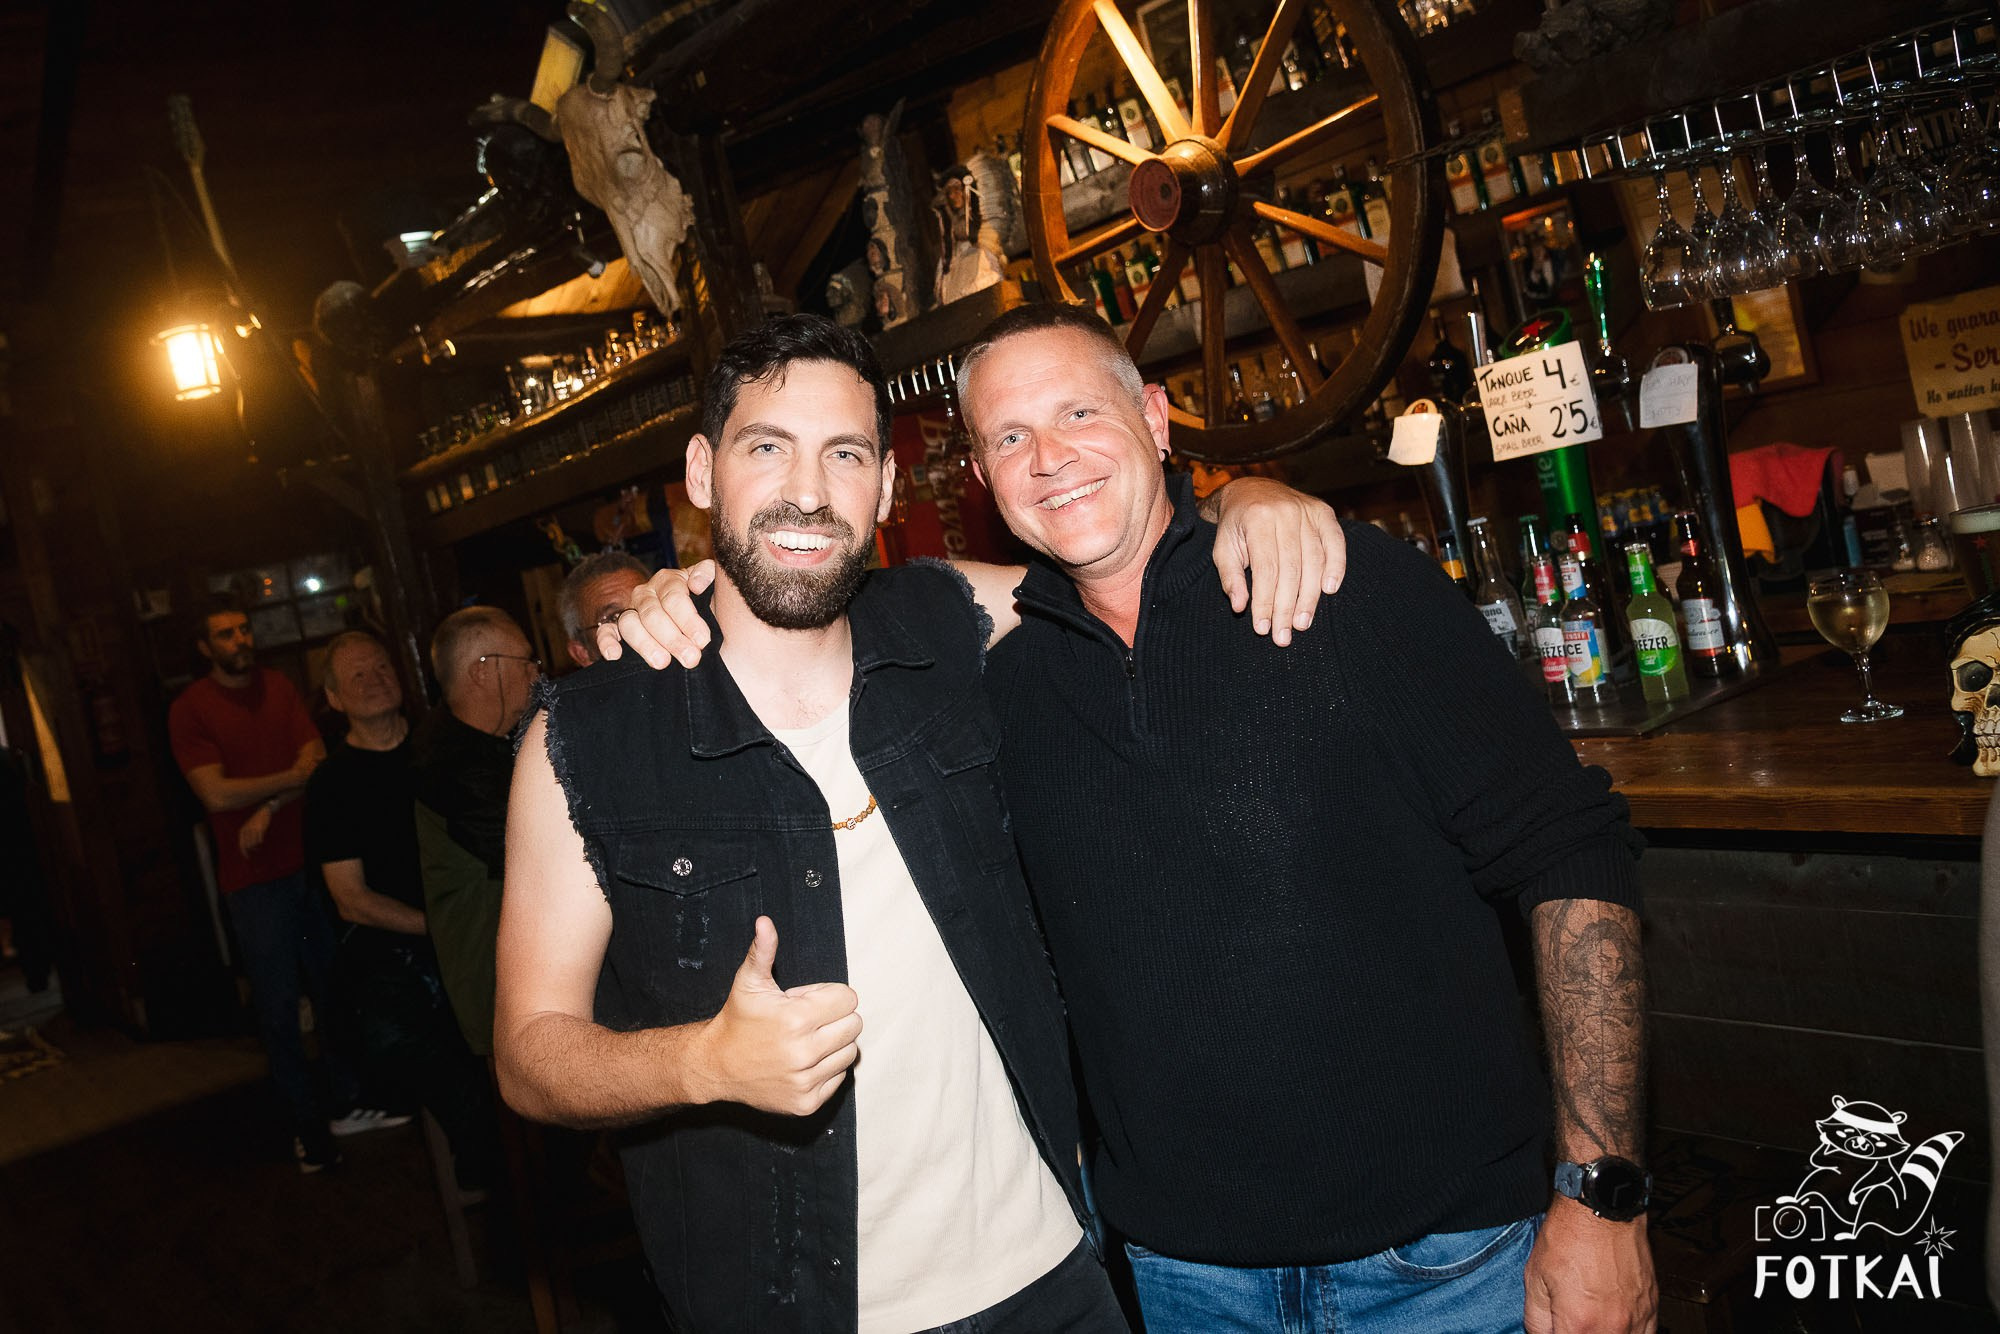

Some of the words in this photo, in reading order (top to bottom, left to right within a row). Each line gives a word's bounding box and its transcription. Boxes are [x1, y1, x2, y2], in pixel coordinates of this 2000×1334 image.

[1909, 316, 1940, 342] We
[1479, 366, 1534, 393] TANQUE
[1542, 358, 1567, 390] 4
[1947, 383, 1985, 400] matter
[1492, 413, 1531, 437] CAÑA
[1495, 441, 1519, 454] SMALL
